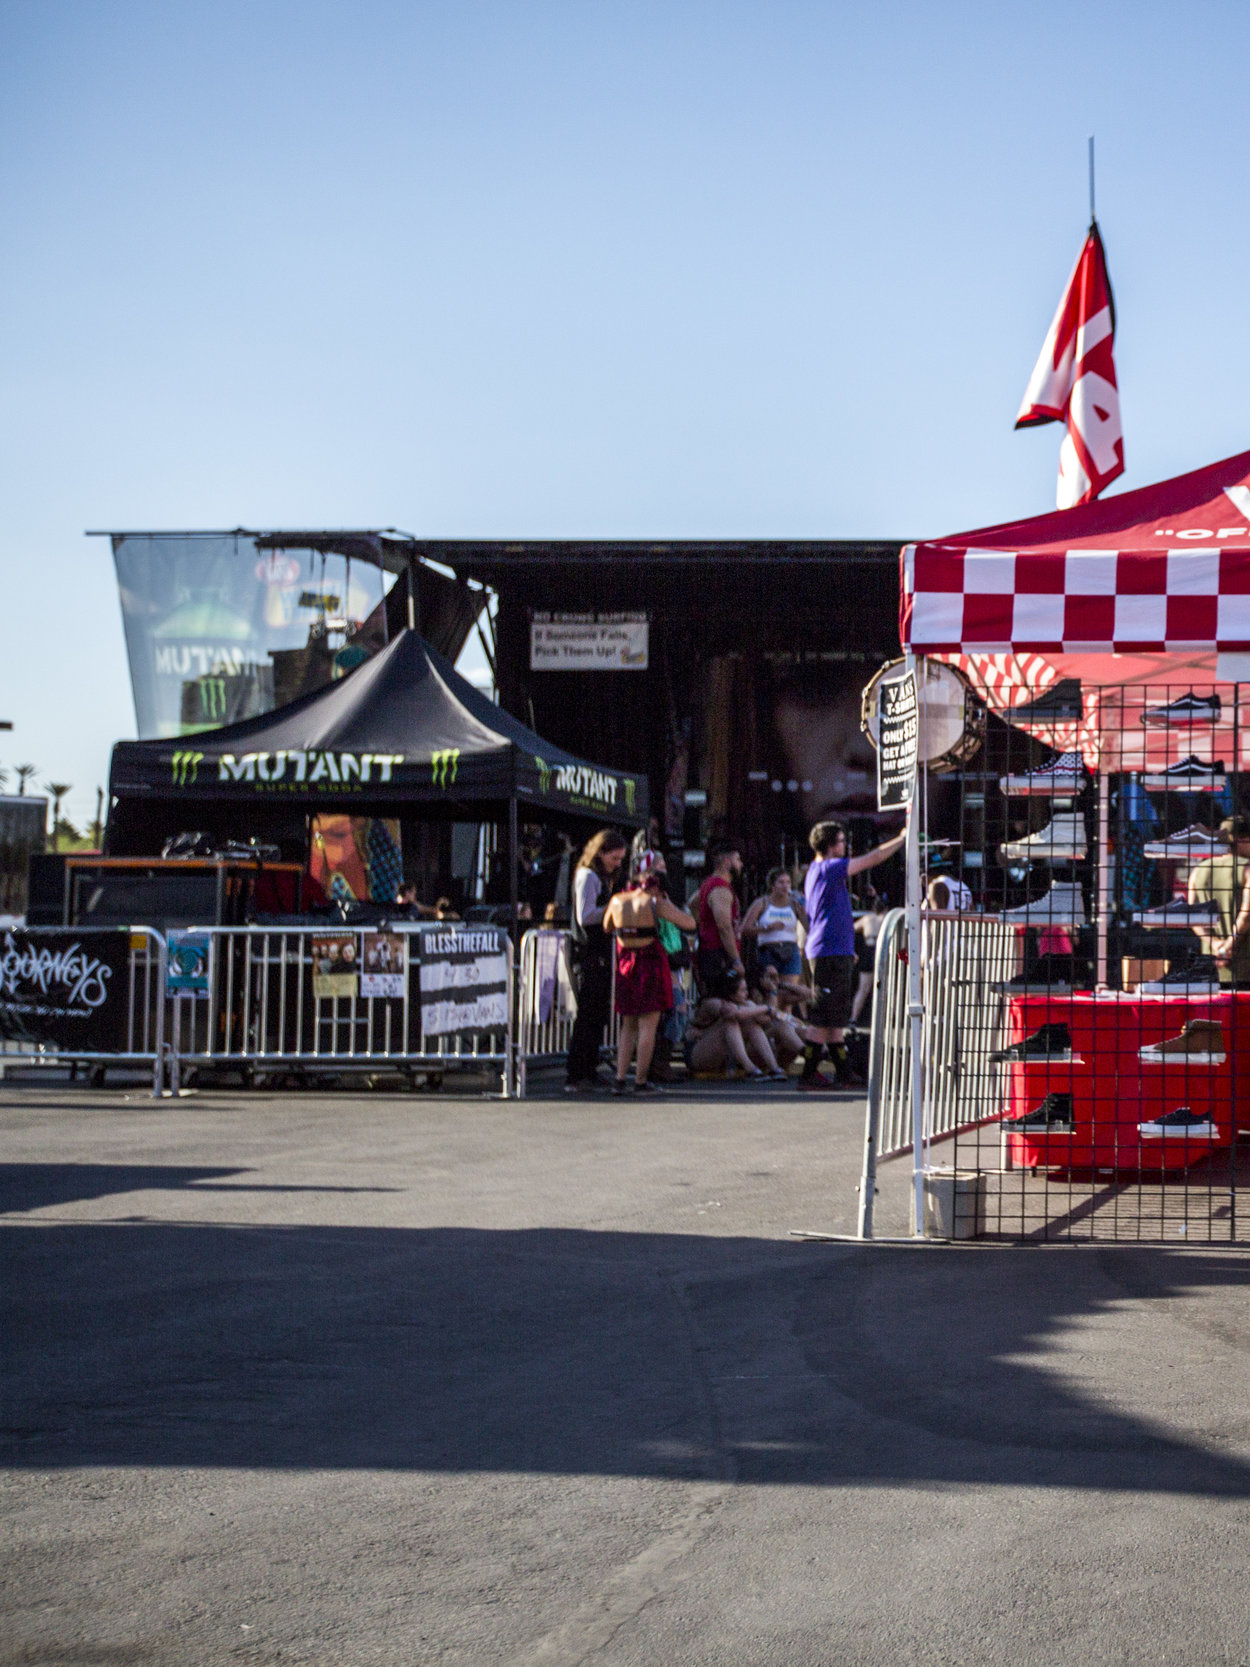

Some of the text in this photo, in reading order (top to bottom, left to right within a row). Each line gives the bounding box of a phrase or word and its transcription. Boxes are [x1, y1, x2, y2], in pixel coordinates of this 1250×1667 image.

[887, 681, 914, 702] VANS
[882, 746, 899, 760] GET
[219, 750, 404, 782] MUTANT
[882, 760, 897, 772] HAT
[553, 764, 618, 805] MUTANT
[425, 932, 501, 954] BLESSTHEFALL
[0, 932, 113, 1007] OURNEYS
